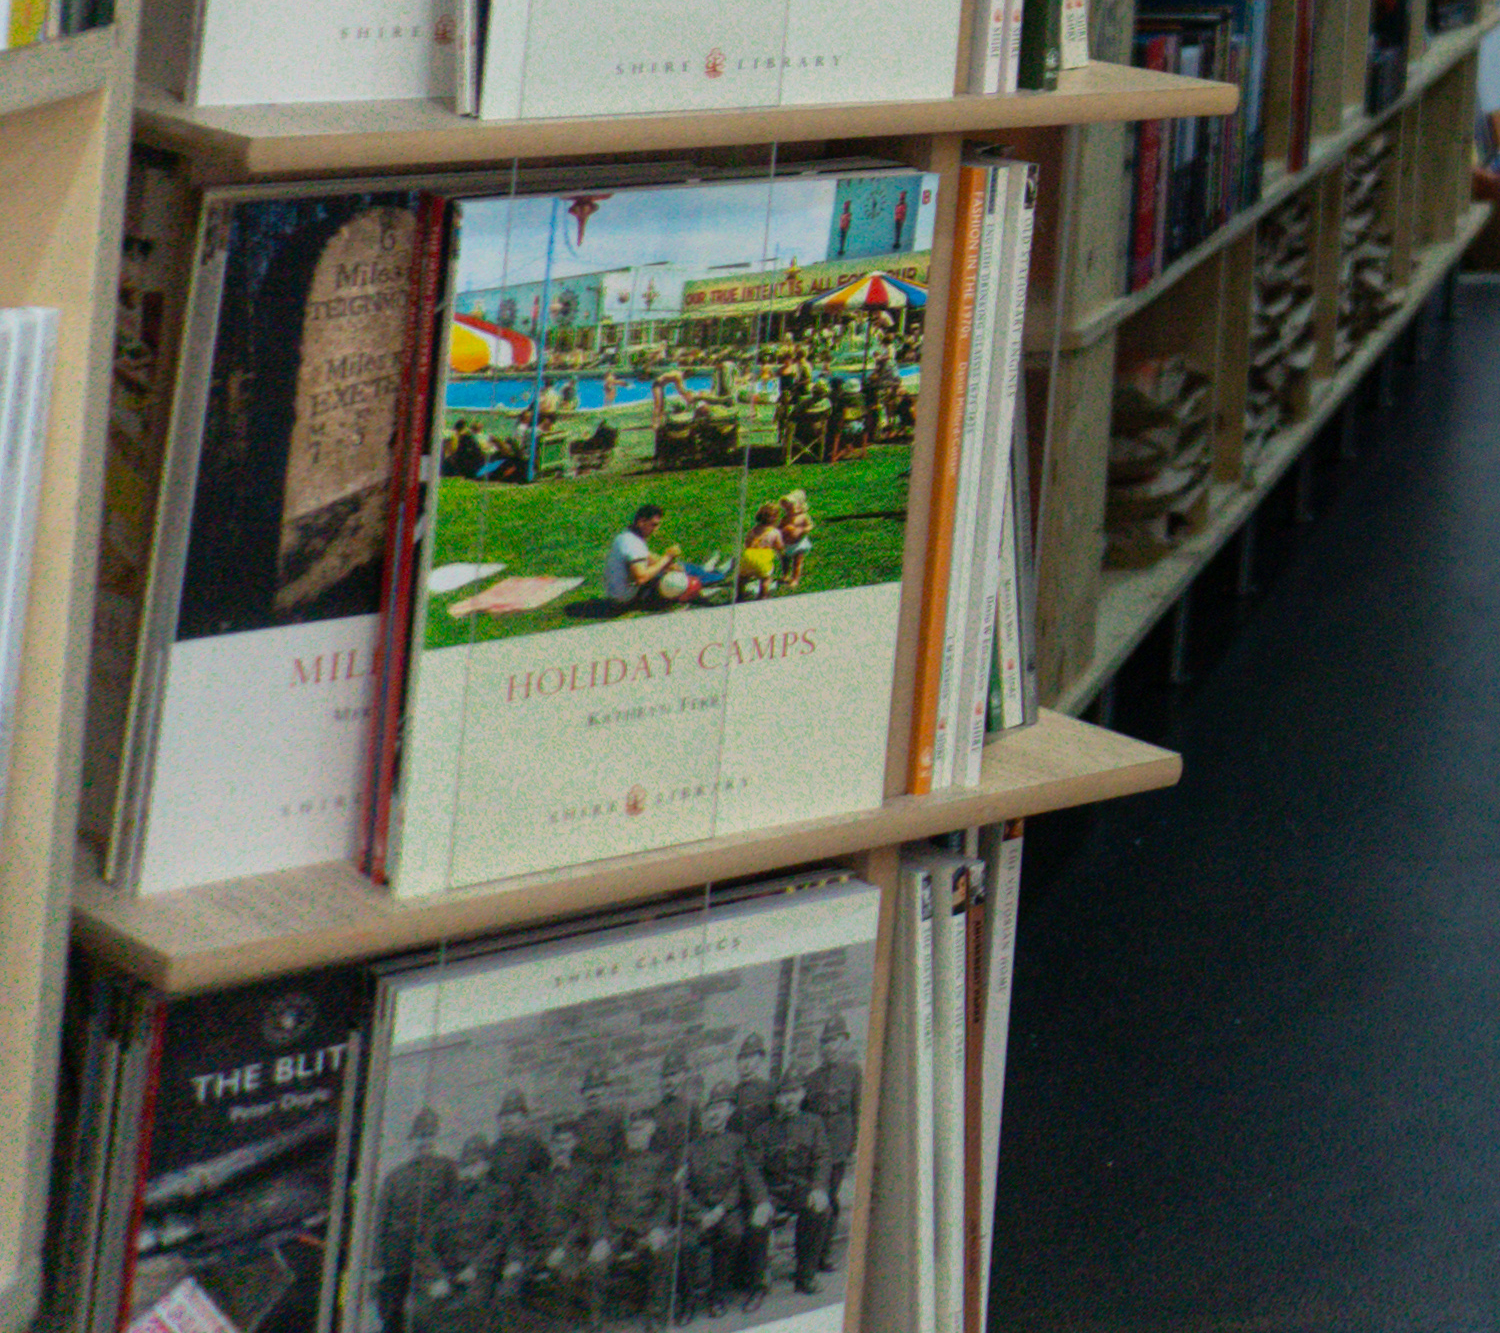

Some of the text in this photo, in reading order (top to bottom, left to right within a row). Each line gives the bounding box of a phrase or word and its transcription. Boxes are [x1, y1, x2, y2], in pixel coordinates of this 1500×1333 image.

[340, 25, 421, 40] SHIRE
[615, 54, 842, 76] SHIRE LIBRARY
[507, 628, 818, 702] HOLIDAY CAMPS
[553, 936, 741, 989] SHIRE CLASSICS
[192, 1047, 347, 1104] THE BLIT
